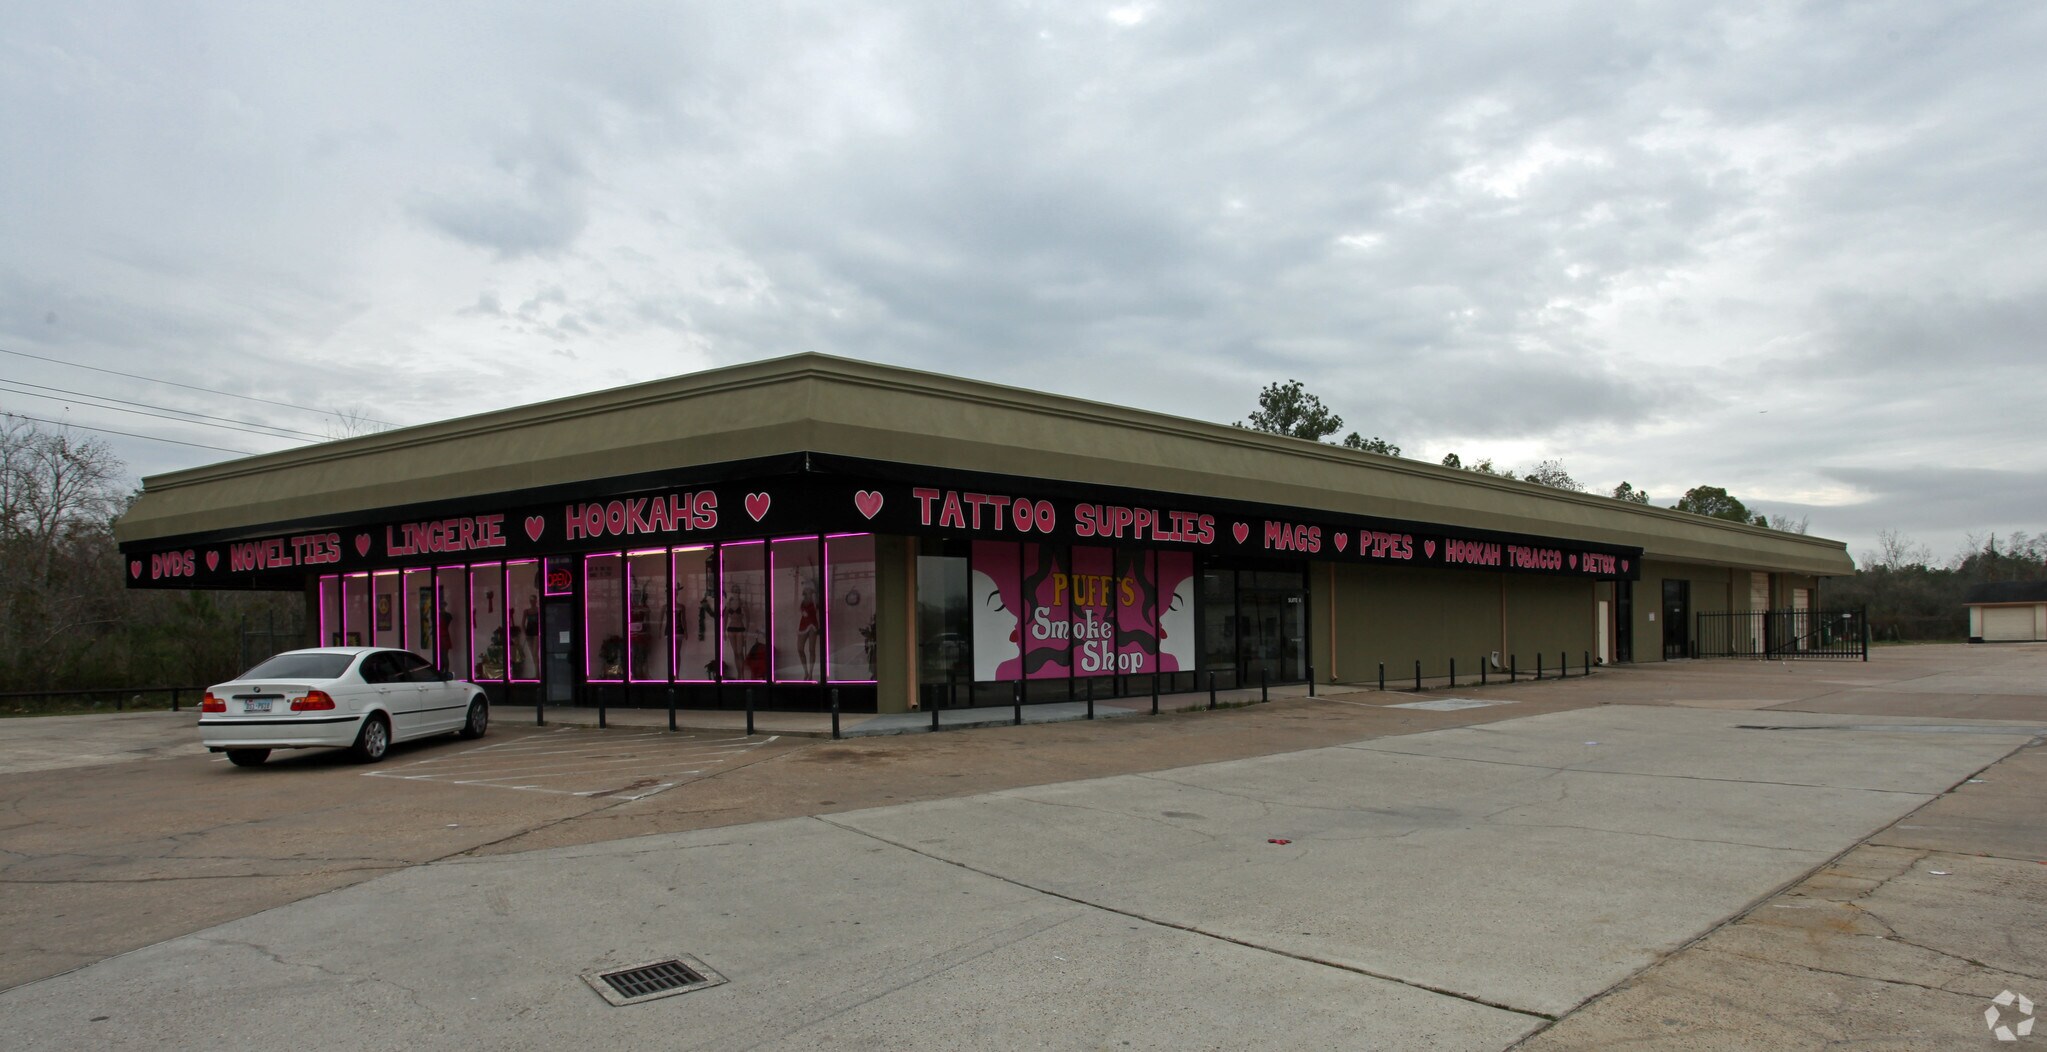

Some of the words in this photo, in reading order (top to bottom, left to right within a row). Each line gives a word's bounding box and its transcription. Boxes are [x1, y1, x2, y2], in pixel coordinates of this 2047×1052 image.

[151, 549, 196, 580] DVDS
[230, 532, 342, 572] NOVELTIES
[385, 513, 507, 558] LINGERIE
[565, 489, 719, 540] HOOKAHS
[912, 487, 1056, 534] TATTOO
[1074, 502, 1216, 545] SUPPLIES
[1263, 520, 1322, 554] MAGS
[1359, 529, 1414, 560] PIPES
[1444, 538, 1502, 567] HOOKAH
[1507, 544, 1562, 571] TOBACCO
[1582, 552, 1616, 575] DETOX
[547, 571, 569, 588] OPEN
[1051, 572, 1136, 608] PUFF'S
[1031, 606, 1112, 641] Smoke
[1080, 640, 1144, 674] Shop
